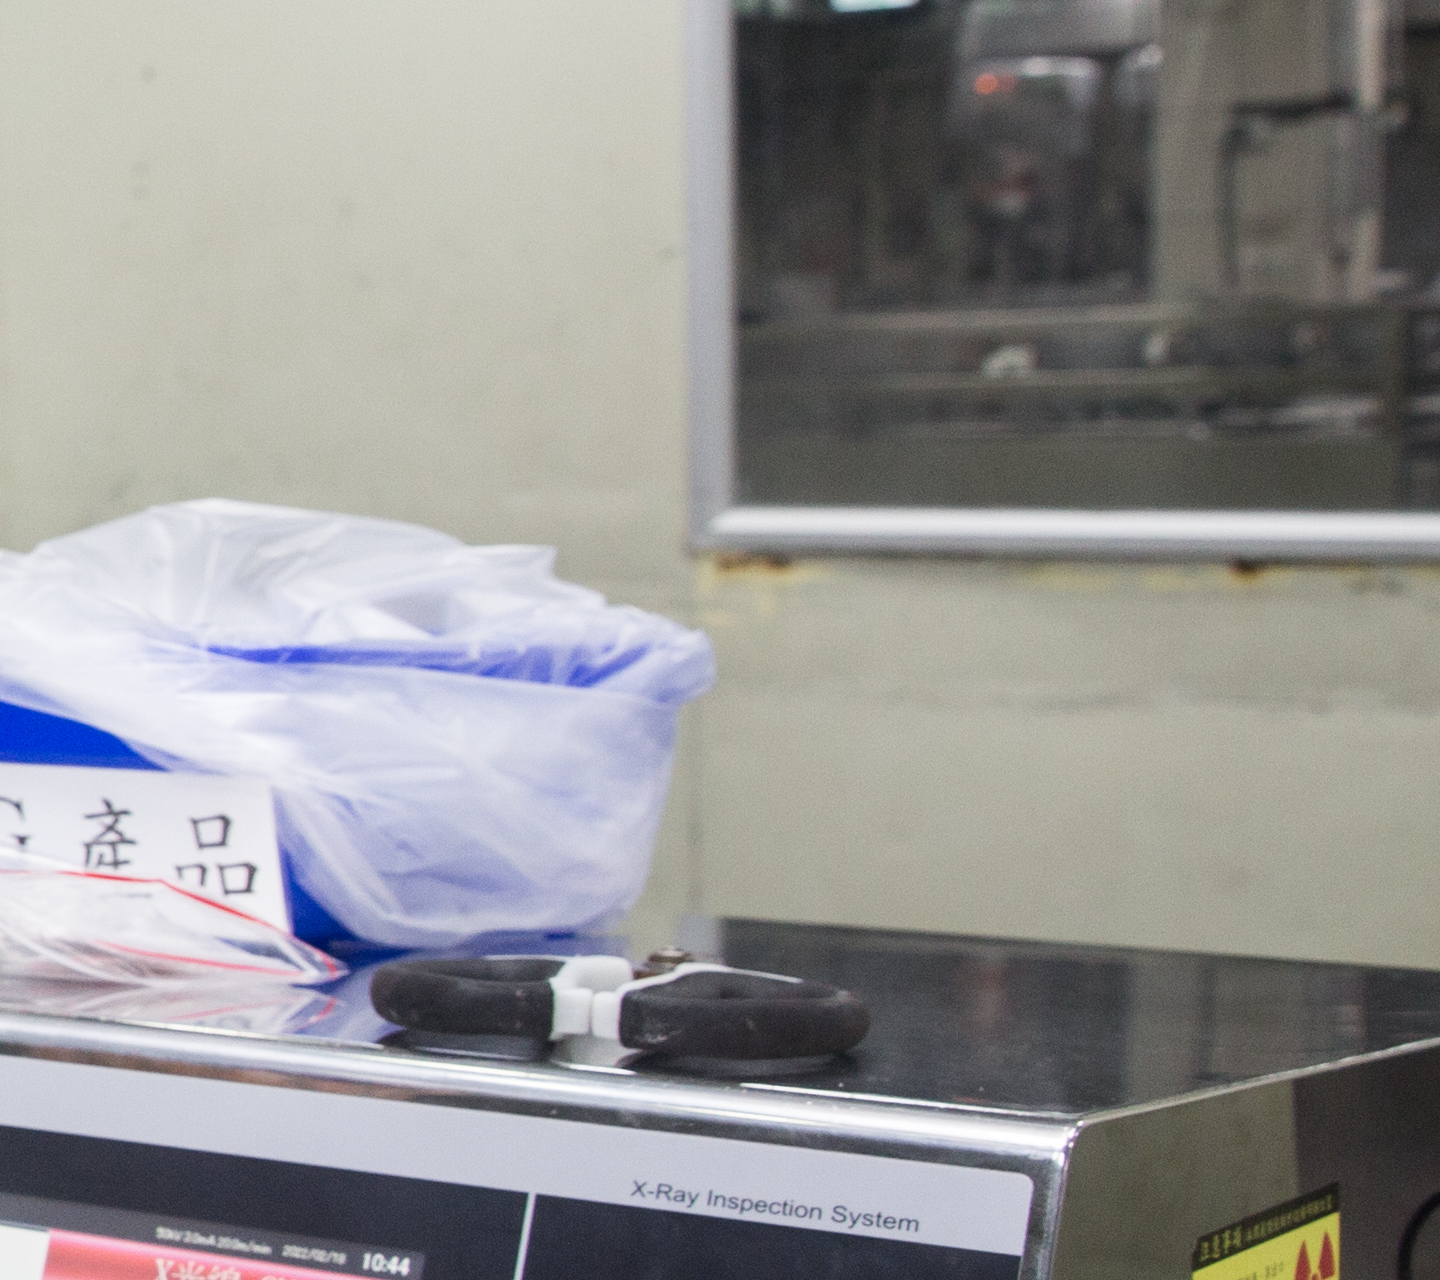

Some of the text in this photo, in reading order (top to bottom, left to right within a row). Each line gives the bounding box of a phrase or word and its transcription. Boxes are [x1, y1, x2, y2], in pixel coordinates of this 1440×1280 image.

[630, 1180, 920, 1233] X-Ray Inspection System
[362, 1252, 411, 1276] 10:44
